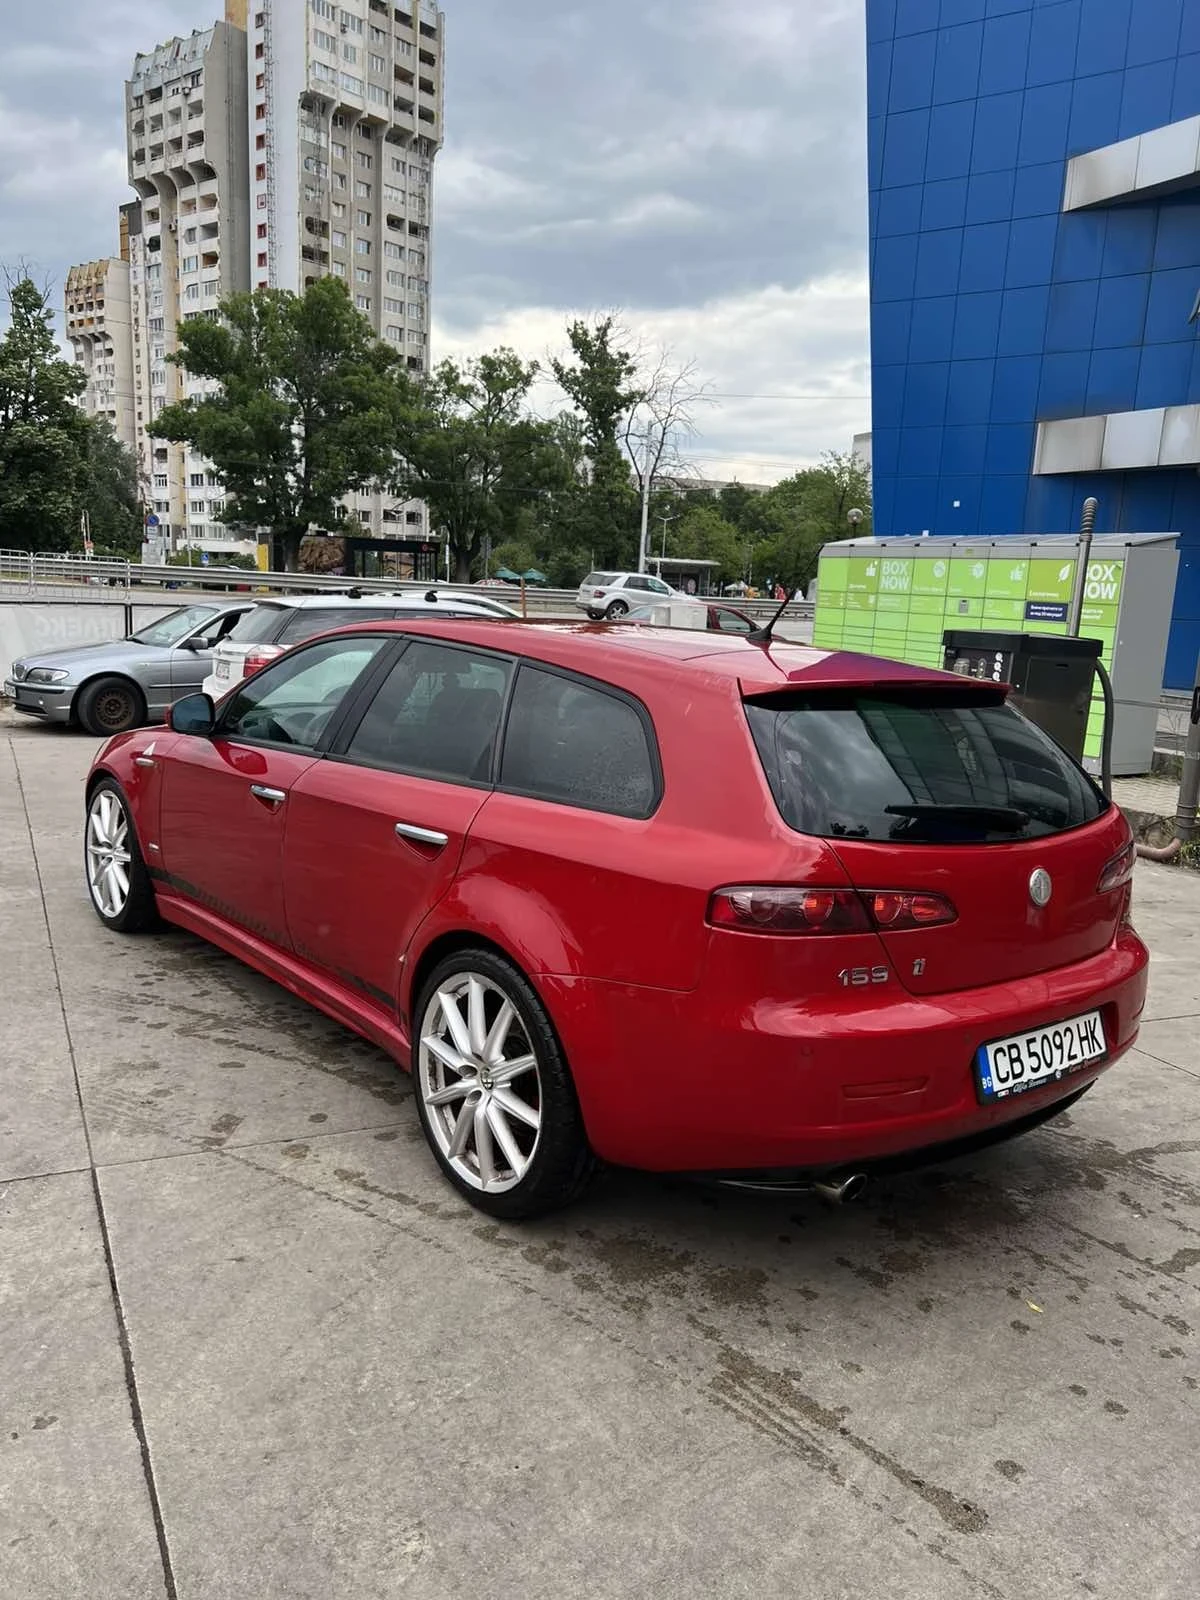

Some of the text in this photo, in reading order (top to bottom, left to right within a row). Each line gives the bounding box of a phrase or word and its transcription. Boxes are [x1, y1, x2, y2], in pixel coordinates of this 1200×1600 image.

[882, 560, 909, 576] BOX
[1085, 563, 1116, 582] OX
[880, 575, 909, 590] NOW
[1083, 581, 1117, 600] OW
[838, 966, 888, 986] 159
[982, 1076, 992, 1089] BG
